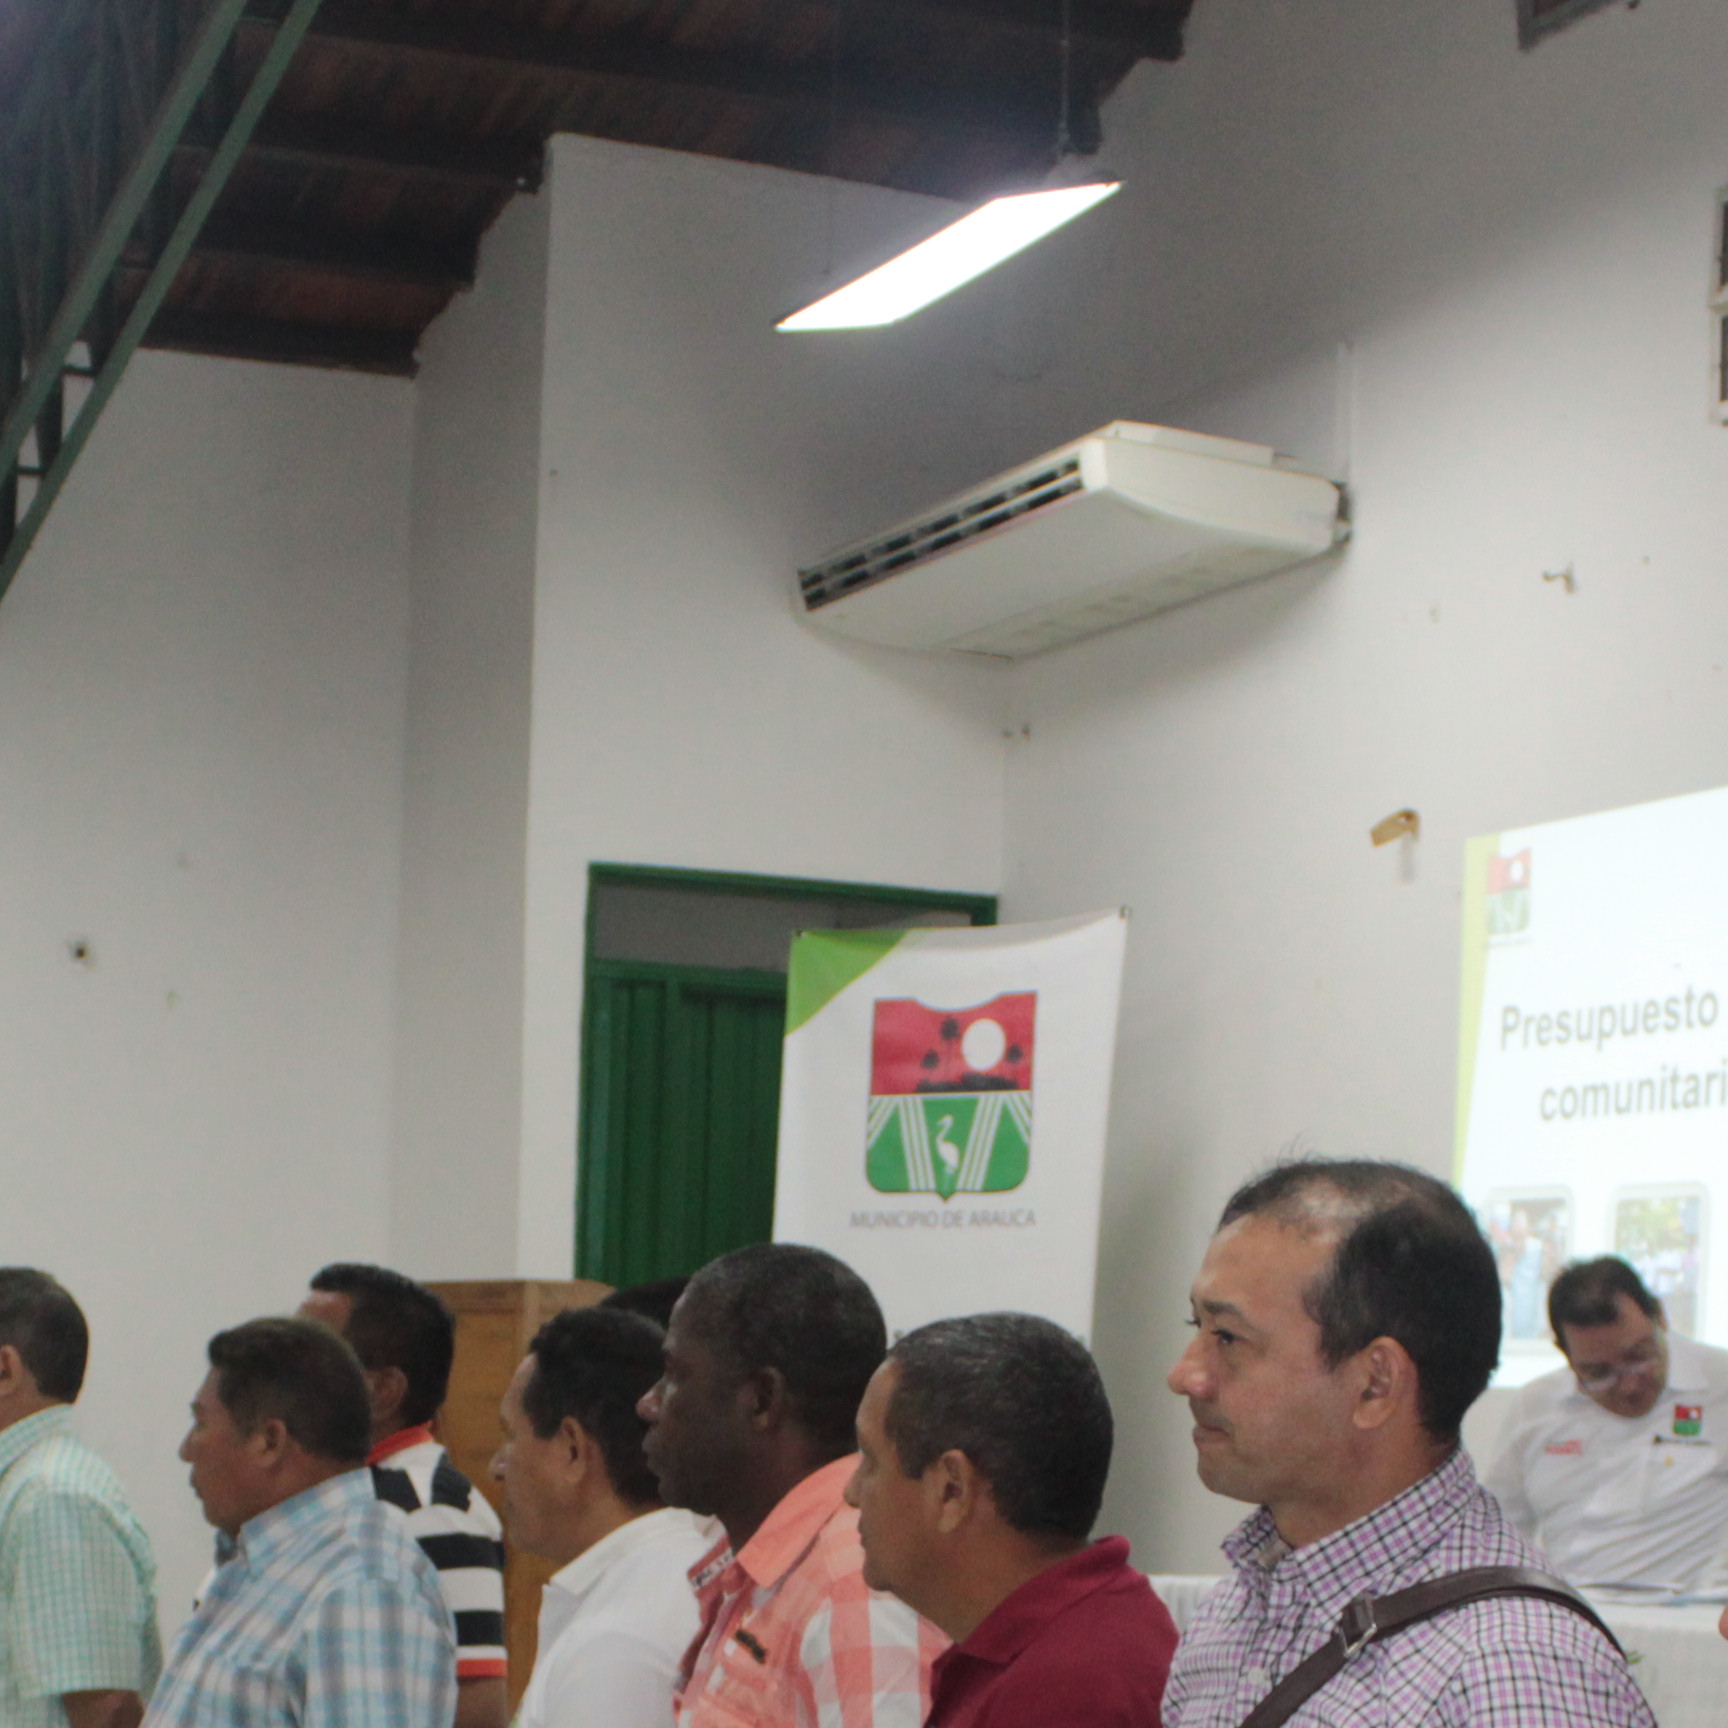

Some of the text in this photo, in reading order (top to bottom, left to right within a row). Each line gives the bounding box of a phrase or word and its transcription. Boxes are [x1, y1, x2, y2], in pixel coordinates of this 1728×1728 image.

[1501, 988, 1718, 1050] Presupuesto
[850, 1208, 1035, 1229] MUNICIPIO DE ARAUCA
